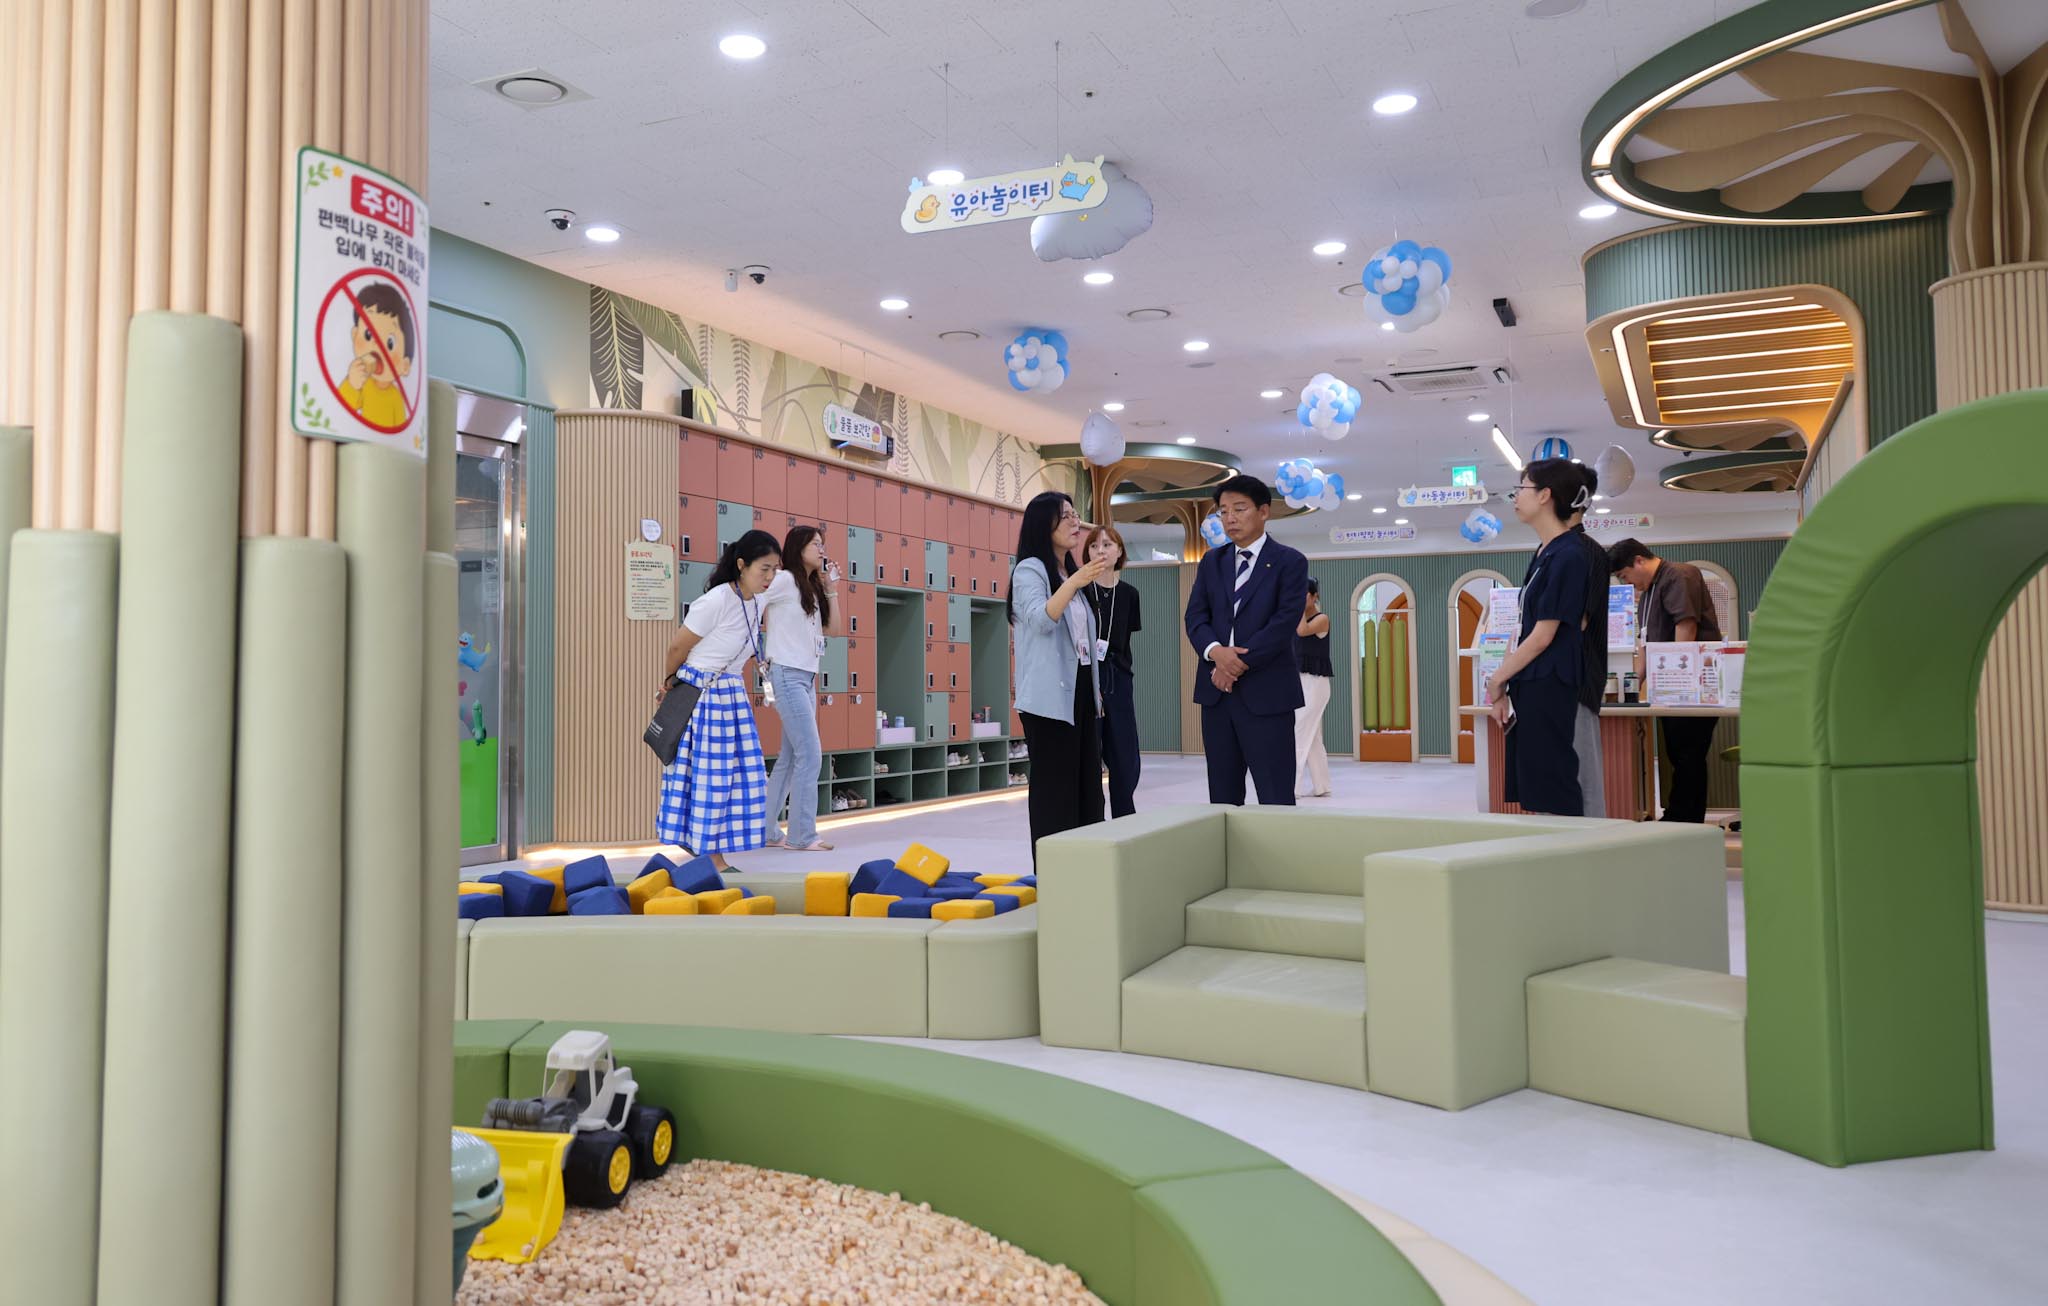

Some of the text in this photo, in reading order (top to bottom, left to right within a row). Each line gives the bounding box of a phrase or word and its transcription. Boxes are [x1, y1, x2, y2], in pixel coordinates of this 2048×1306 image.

[951, 181, 1049, 216] 유아놀이터
[360, 183, 410, 231] 주의!
[318, 208, 378, 241] 편백나무
[383, 230, 404, 255] 작은
[336, 236, 366, 261] 입에
[372, 248, 394, 271] 넣지
[680, 430, 688, 441] 01
[719, 439, 728, 450] 02
[1421, 490, 1465, 501] 아동놀이터
[680, 496, 688, 508] 19
[718, 504, 728, 515] 20
[754, 510, 762, 521] 21
[848, 528, 856, 538] 24
[679, 563, 689, 575] 37
